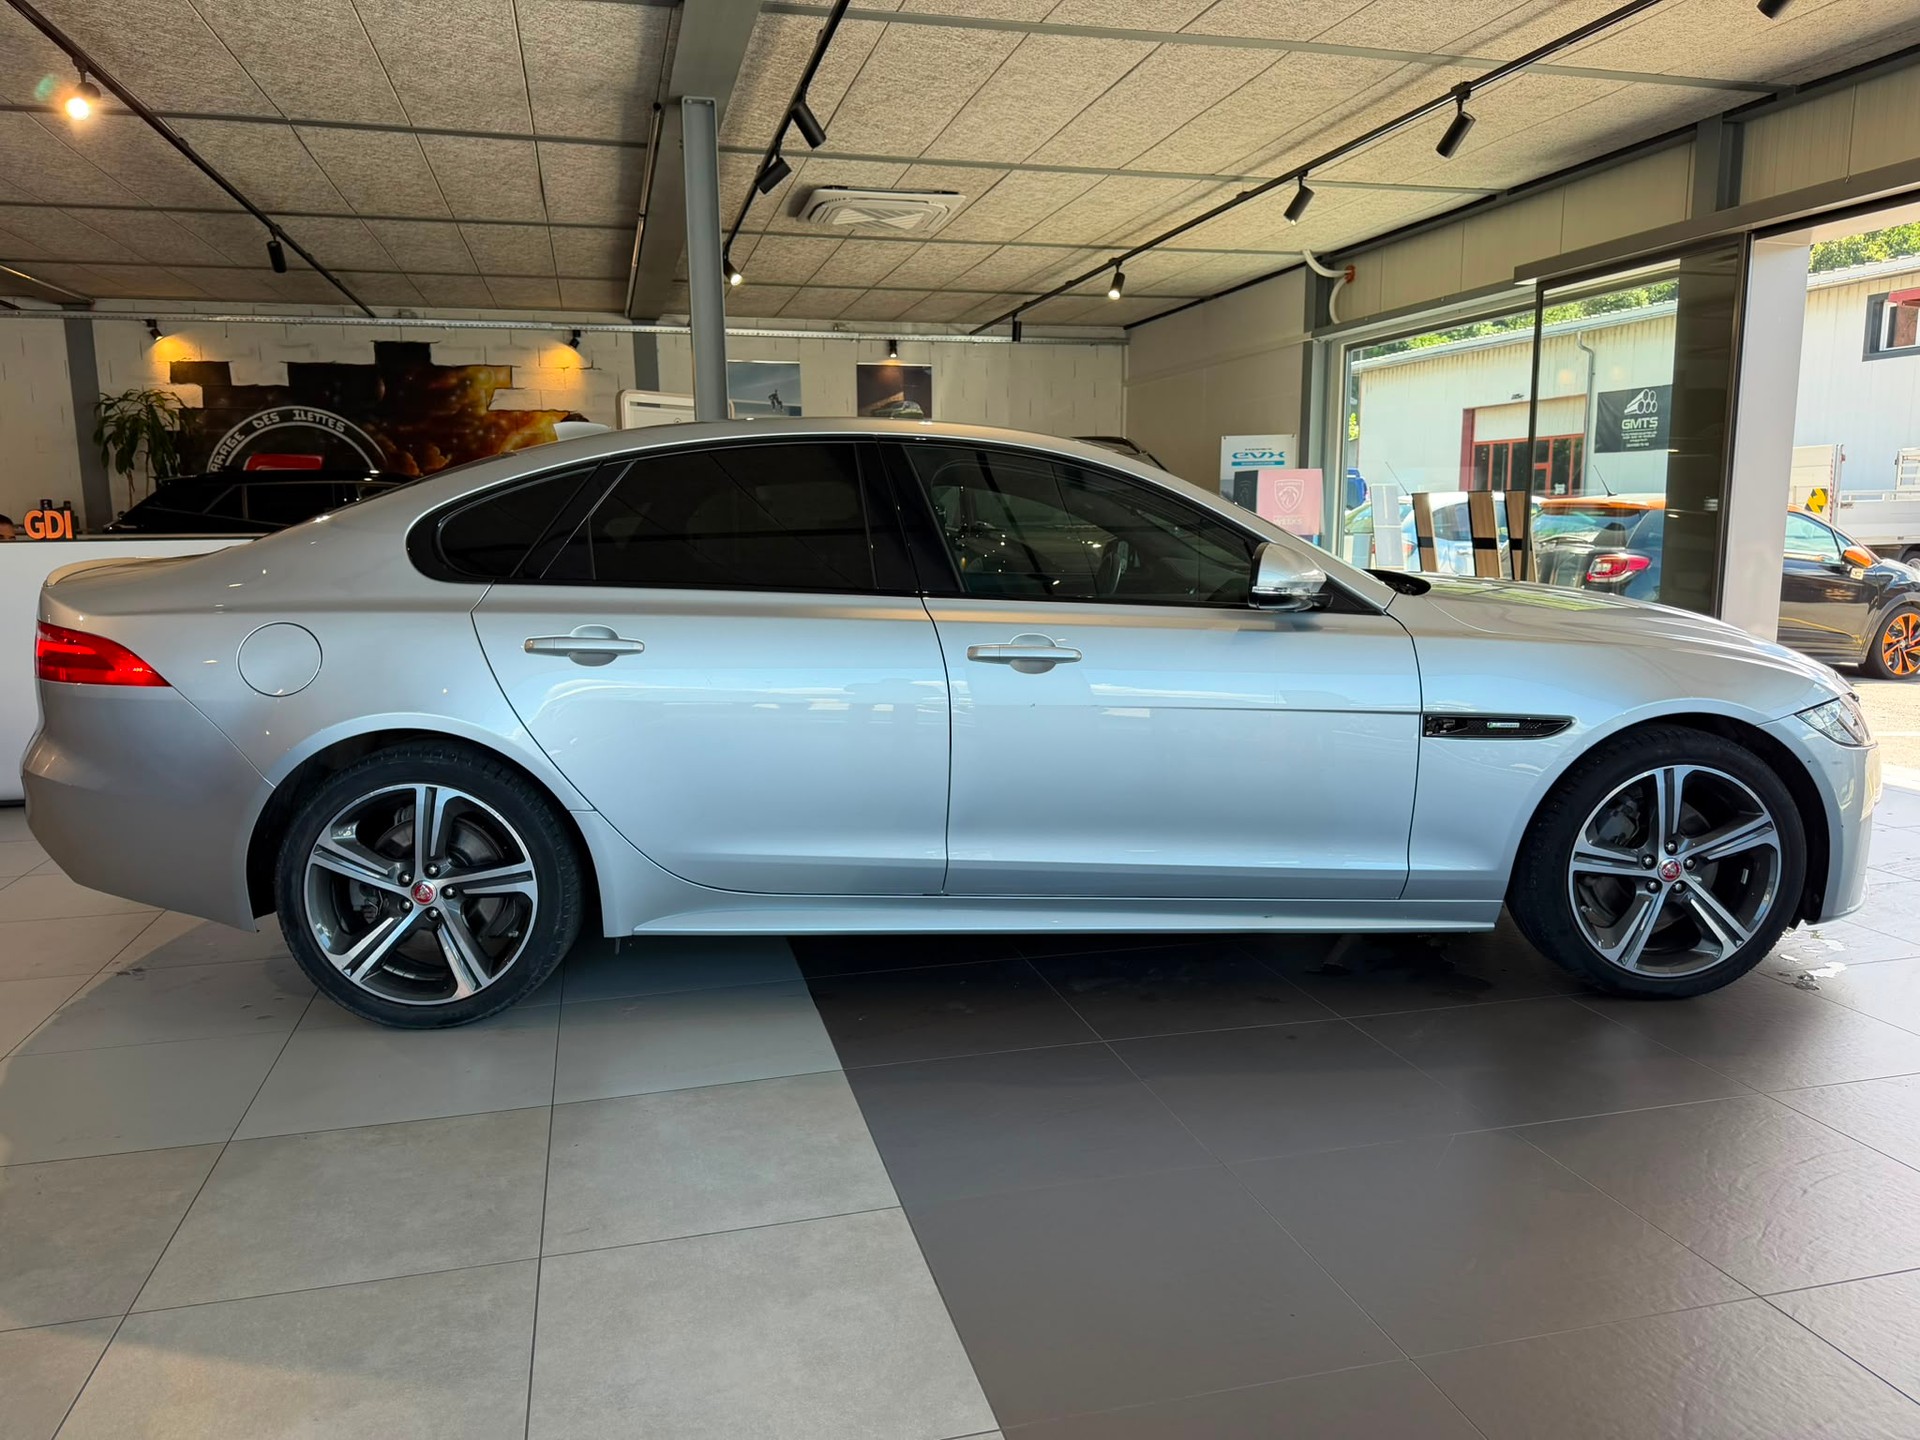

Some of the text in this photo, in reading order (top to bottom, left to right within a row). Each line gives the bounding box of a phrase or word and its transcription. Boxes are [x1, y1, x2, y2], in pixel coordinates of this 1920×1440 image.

[1622, 416, 1659, 429] GMTS
[210, 410, 346, 472] ARAGE DES ILETTES
[24, 509, 73, 540] GDI
